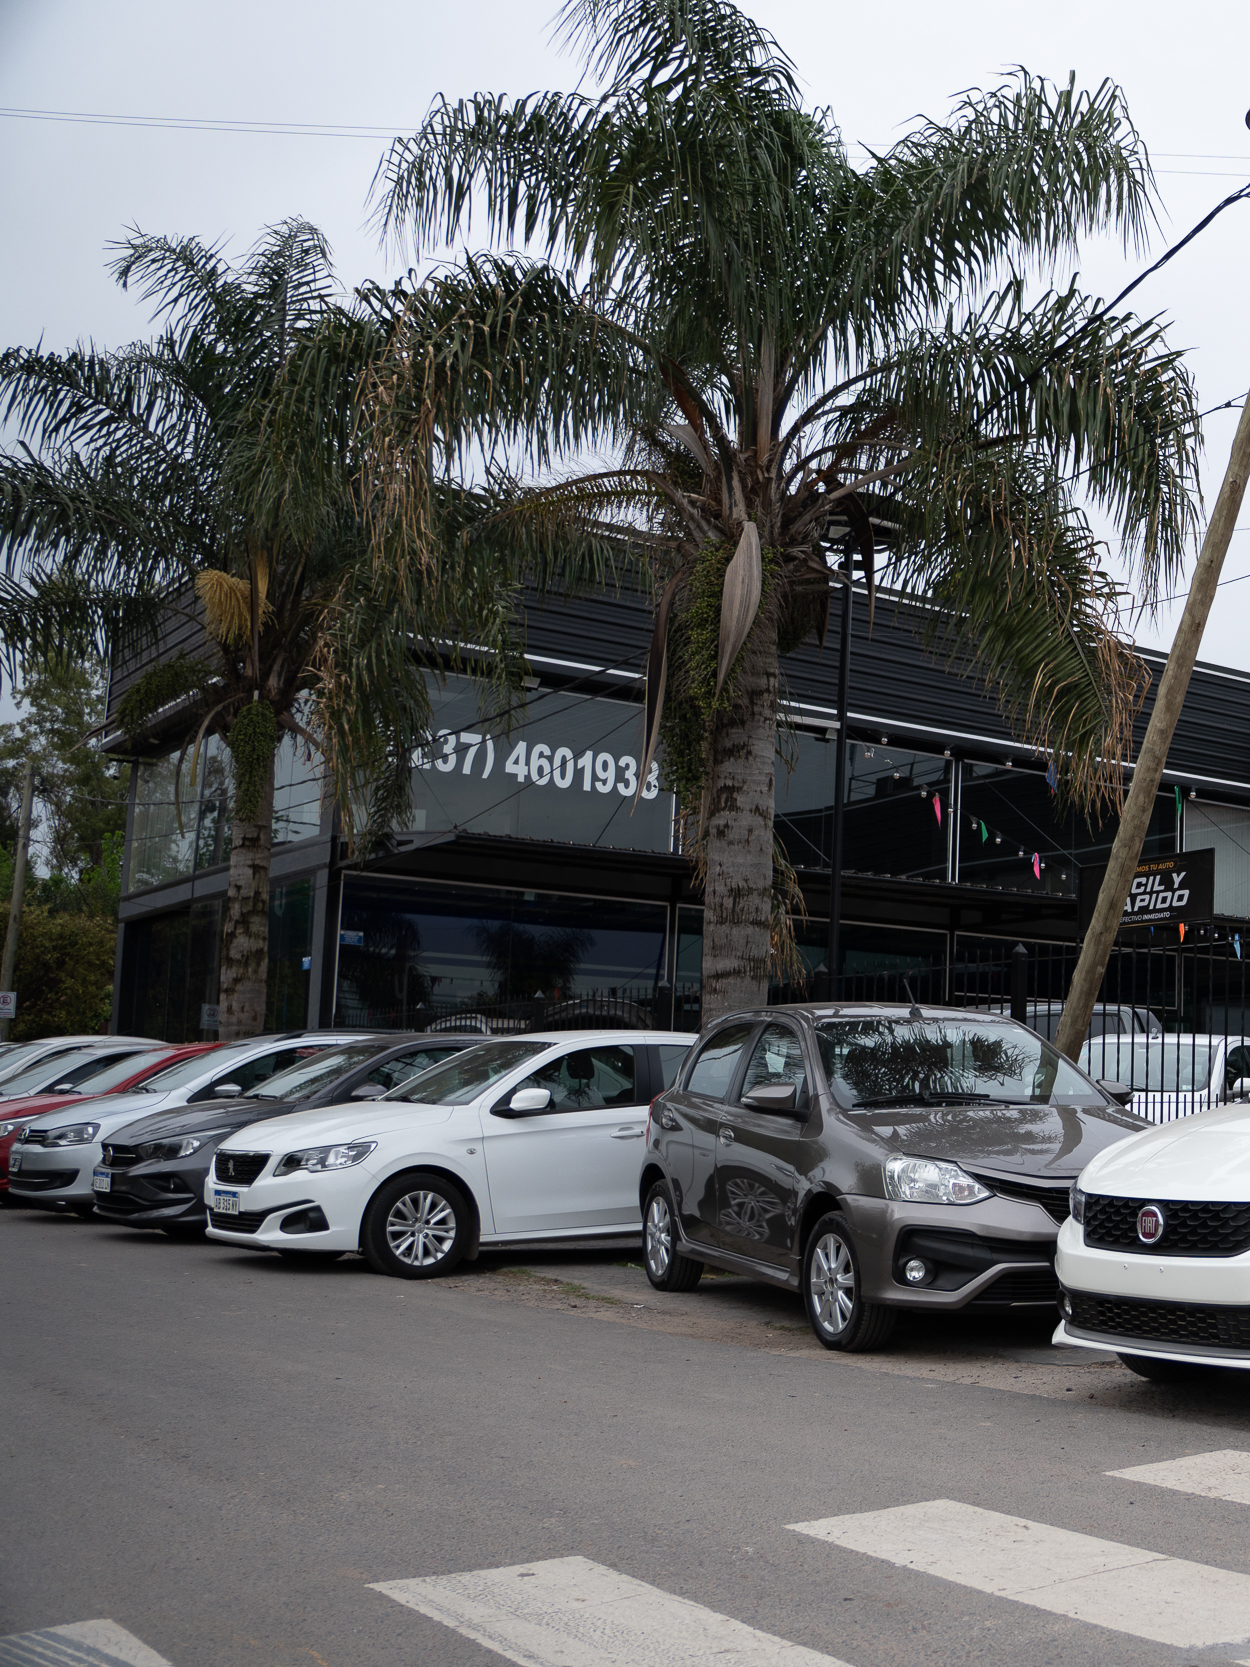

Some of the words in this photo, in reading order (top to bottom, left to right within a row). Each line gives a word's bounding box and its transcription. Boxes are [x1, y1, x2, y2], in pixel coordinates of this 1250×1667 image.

[1158, 861, 1175, 870] AUTO
[1131, 875, 1165, 894] CIL
[1172, 871, 1187, 889] Y
[1143, 911, 1171, 920] INMEDIATO
[1141, 1216, 1157, 1234] FIAT
